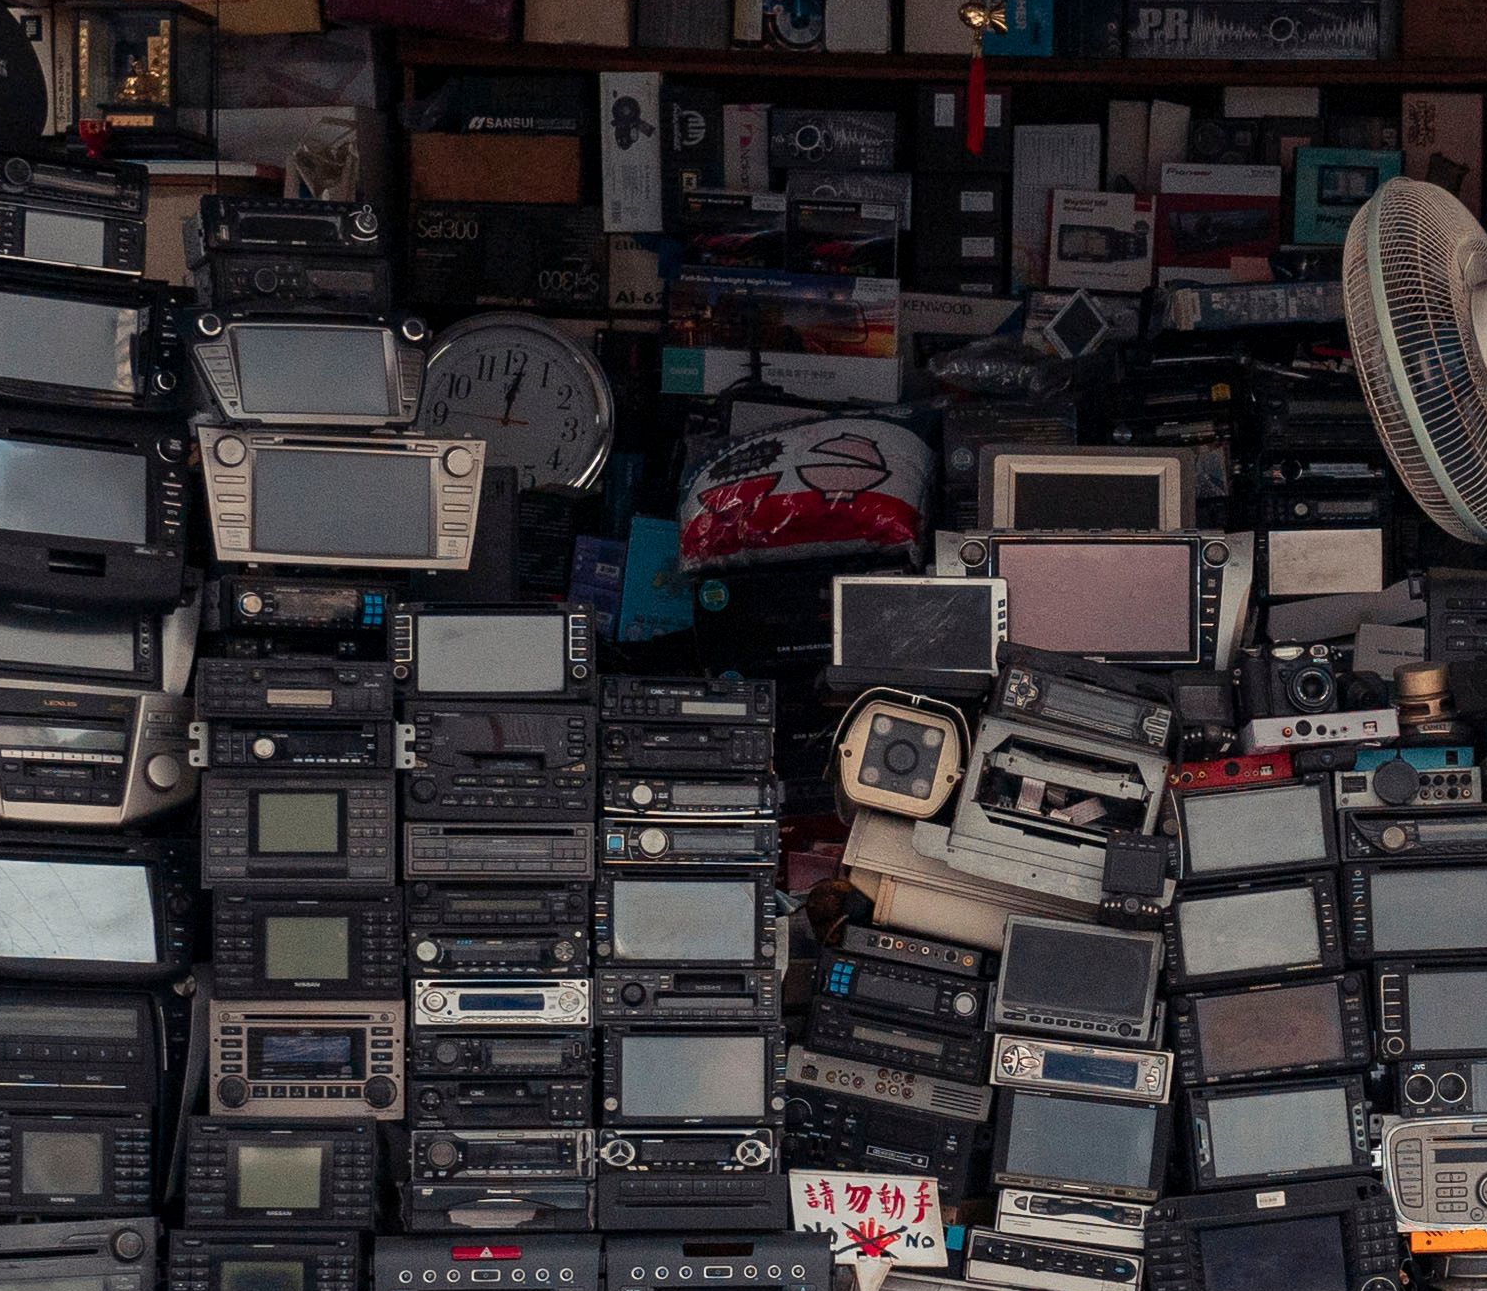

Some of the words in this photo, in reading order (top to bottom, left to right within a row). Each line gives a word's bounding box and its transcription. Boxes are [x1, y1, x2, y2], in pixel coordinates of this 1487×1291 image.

[485, 117, 535, 129] SANSUI
[902, 299, 972, 315] KENWOOD
[803, 1181, 934, 1225] 請勿動手
[904, 1231, 937, 1252] NO
